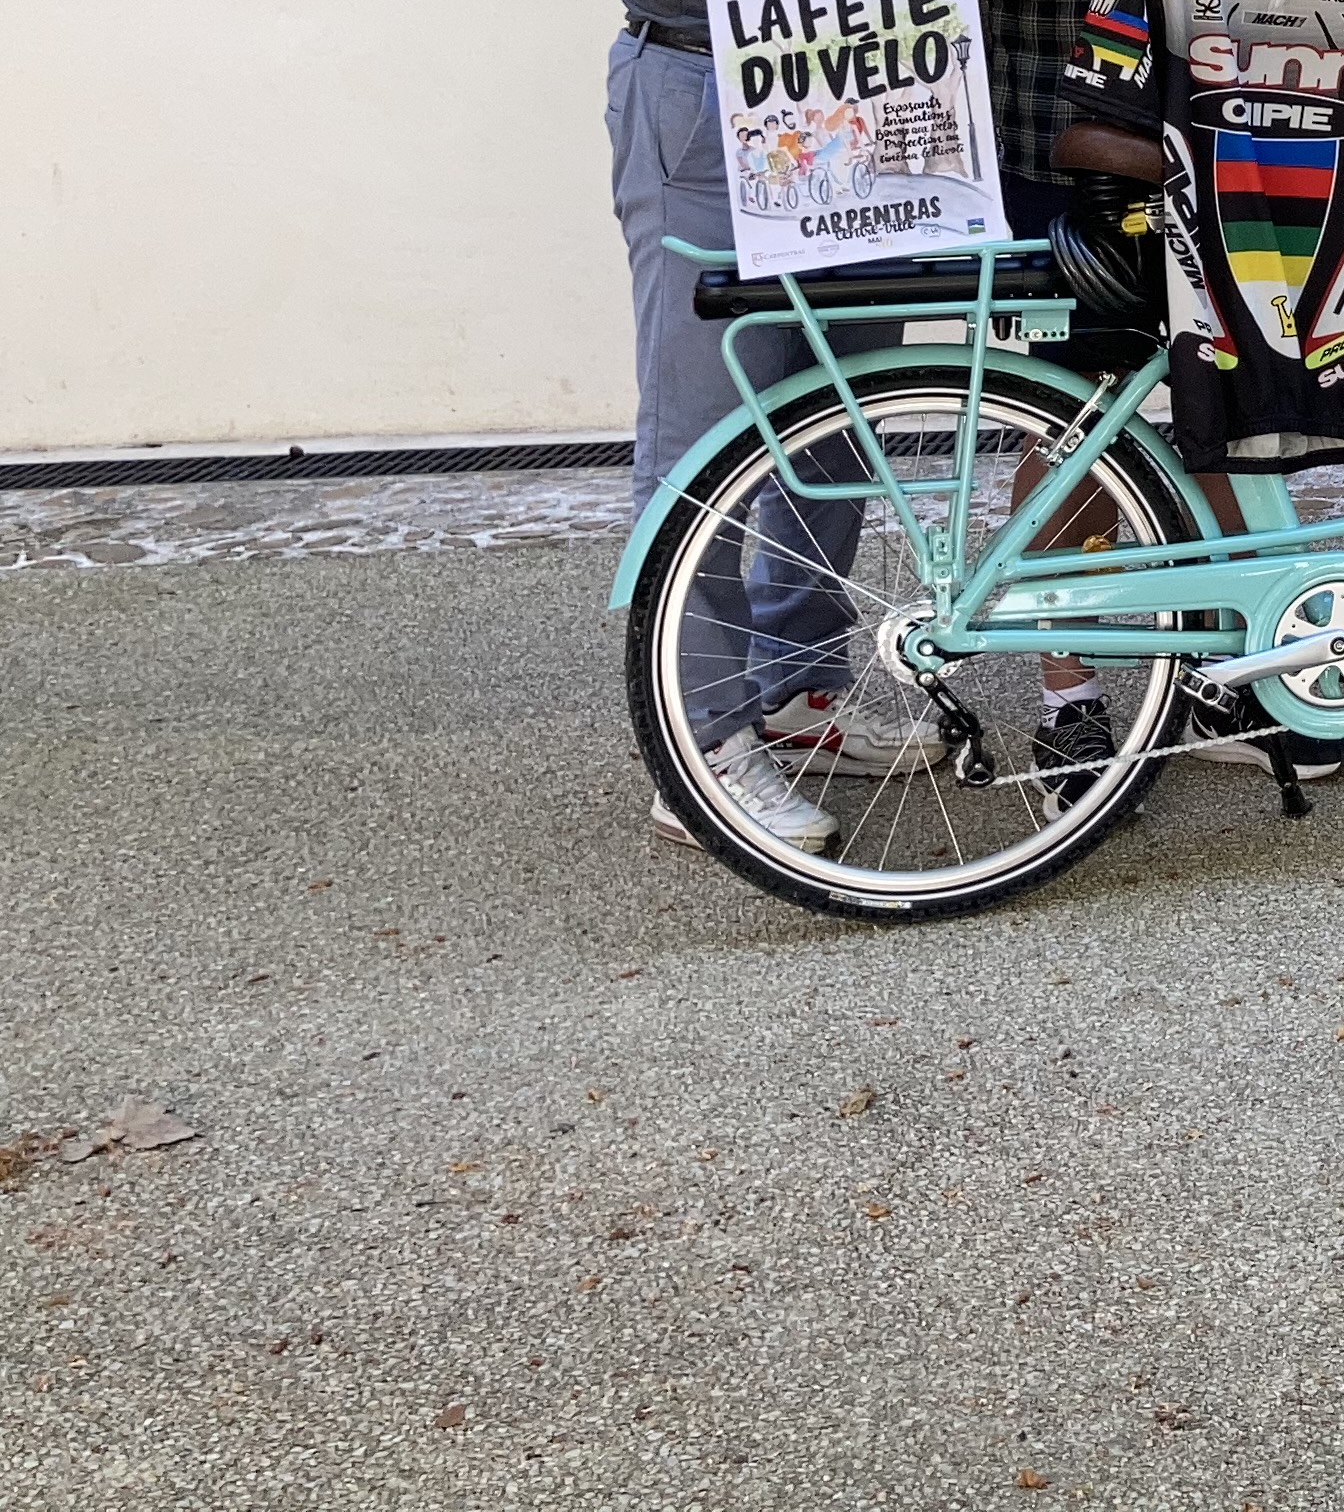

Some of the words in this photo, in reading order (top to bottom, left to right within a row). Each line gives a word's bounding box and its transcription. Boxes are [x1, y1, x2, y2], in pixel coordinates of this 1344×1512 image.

[1251, 12, 1300, 28] MACH
[740, 49, 810, 109] DU
[817, 29, 949, 101] VÉLO
[883, 94, 942, 118] Exposants
[1221, 97, 1334, 131] CIPIE
[881, 109, 952, 128] Animations
[884, 133, 945, 155] Projection
[932, 143, 965, 157] Rivoli
[799, 195, 943, 239] CARPENTRAS
